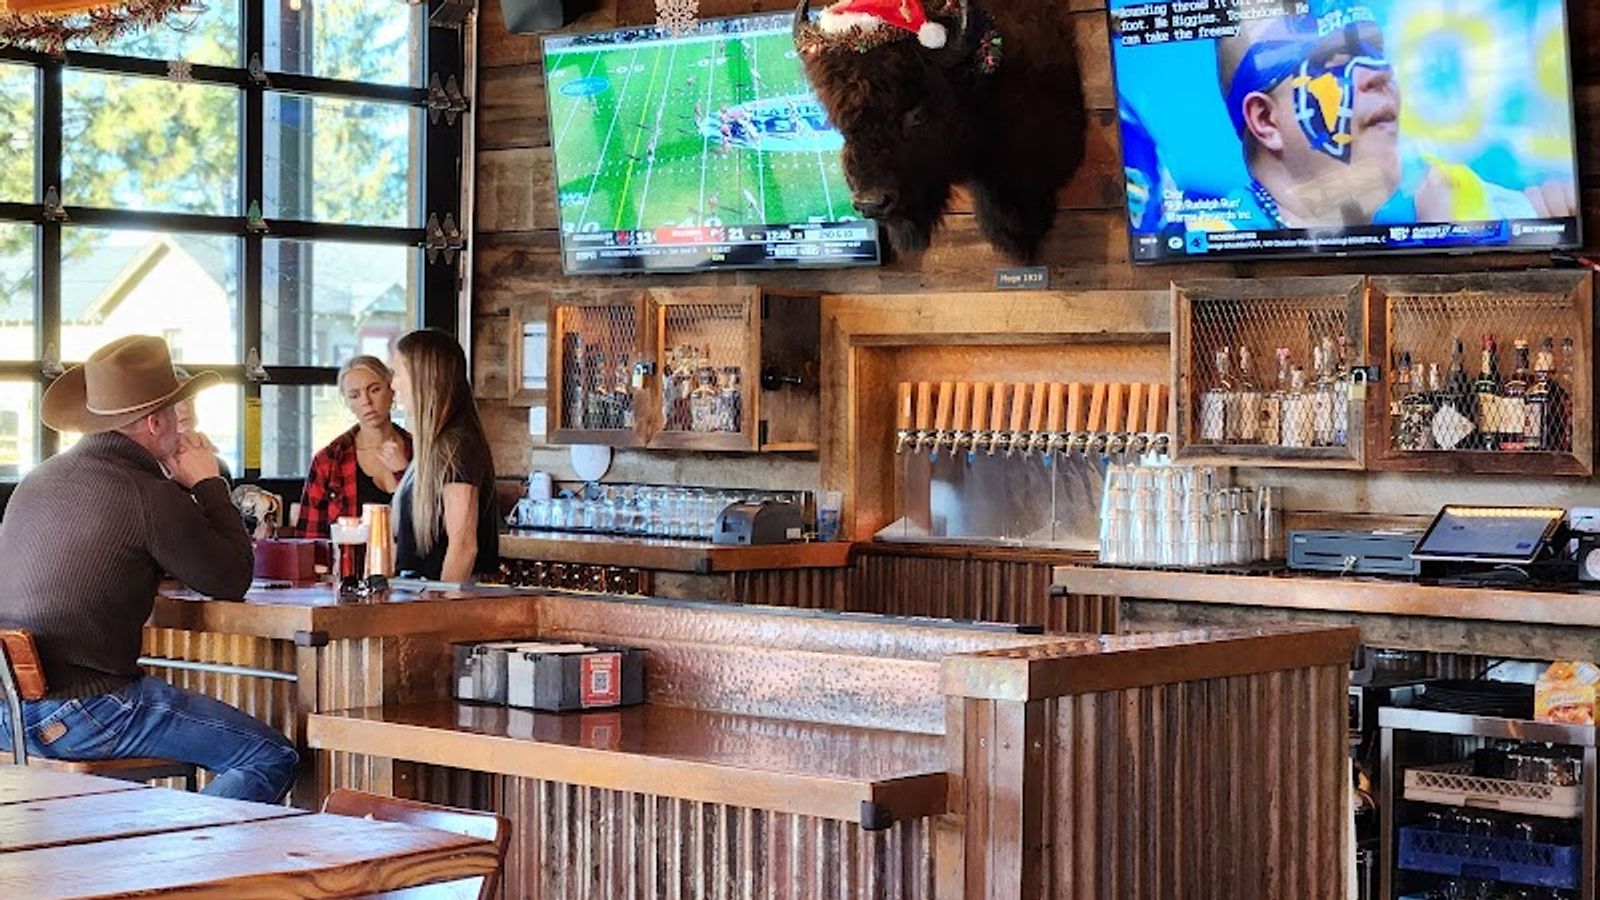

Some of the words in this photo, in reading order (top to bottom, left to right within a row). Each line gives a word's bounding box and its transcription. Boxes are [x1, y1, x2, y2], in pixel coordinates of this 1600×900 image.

[1120, 19, 1149, 32] foot.
[1121, 35, 1141, 45] can
[1145, 31, 1170, 43] take
[1174, 29, 1193, 39] the
